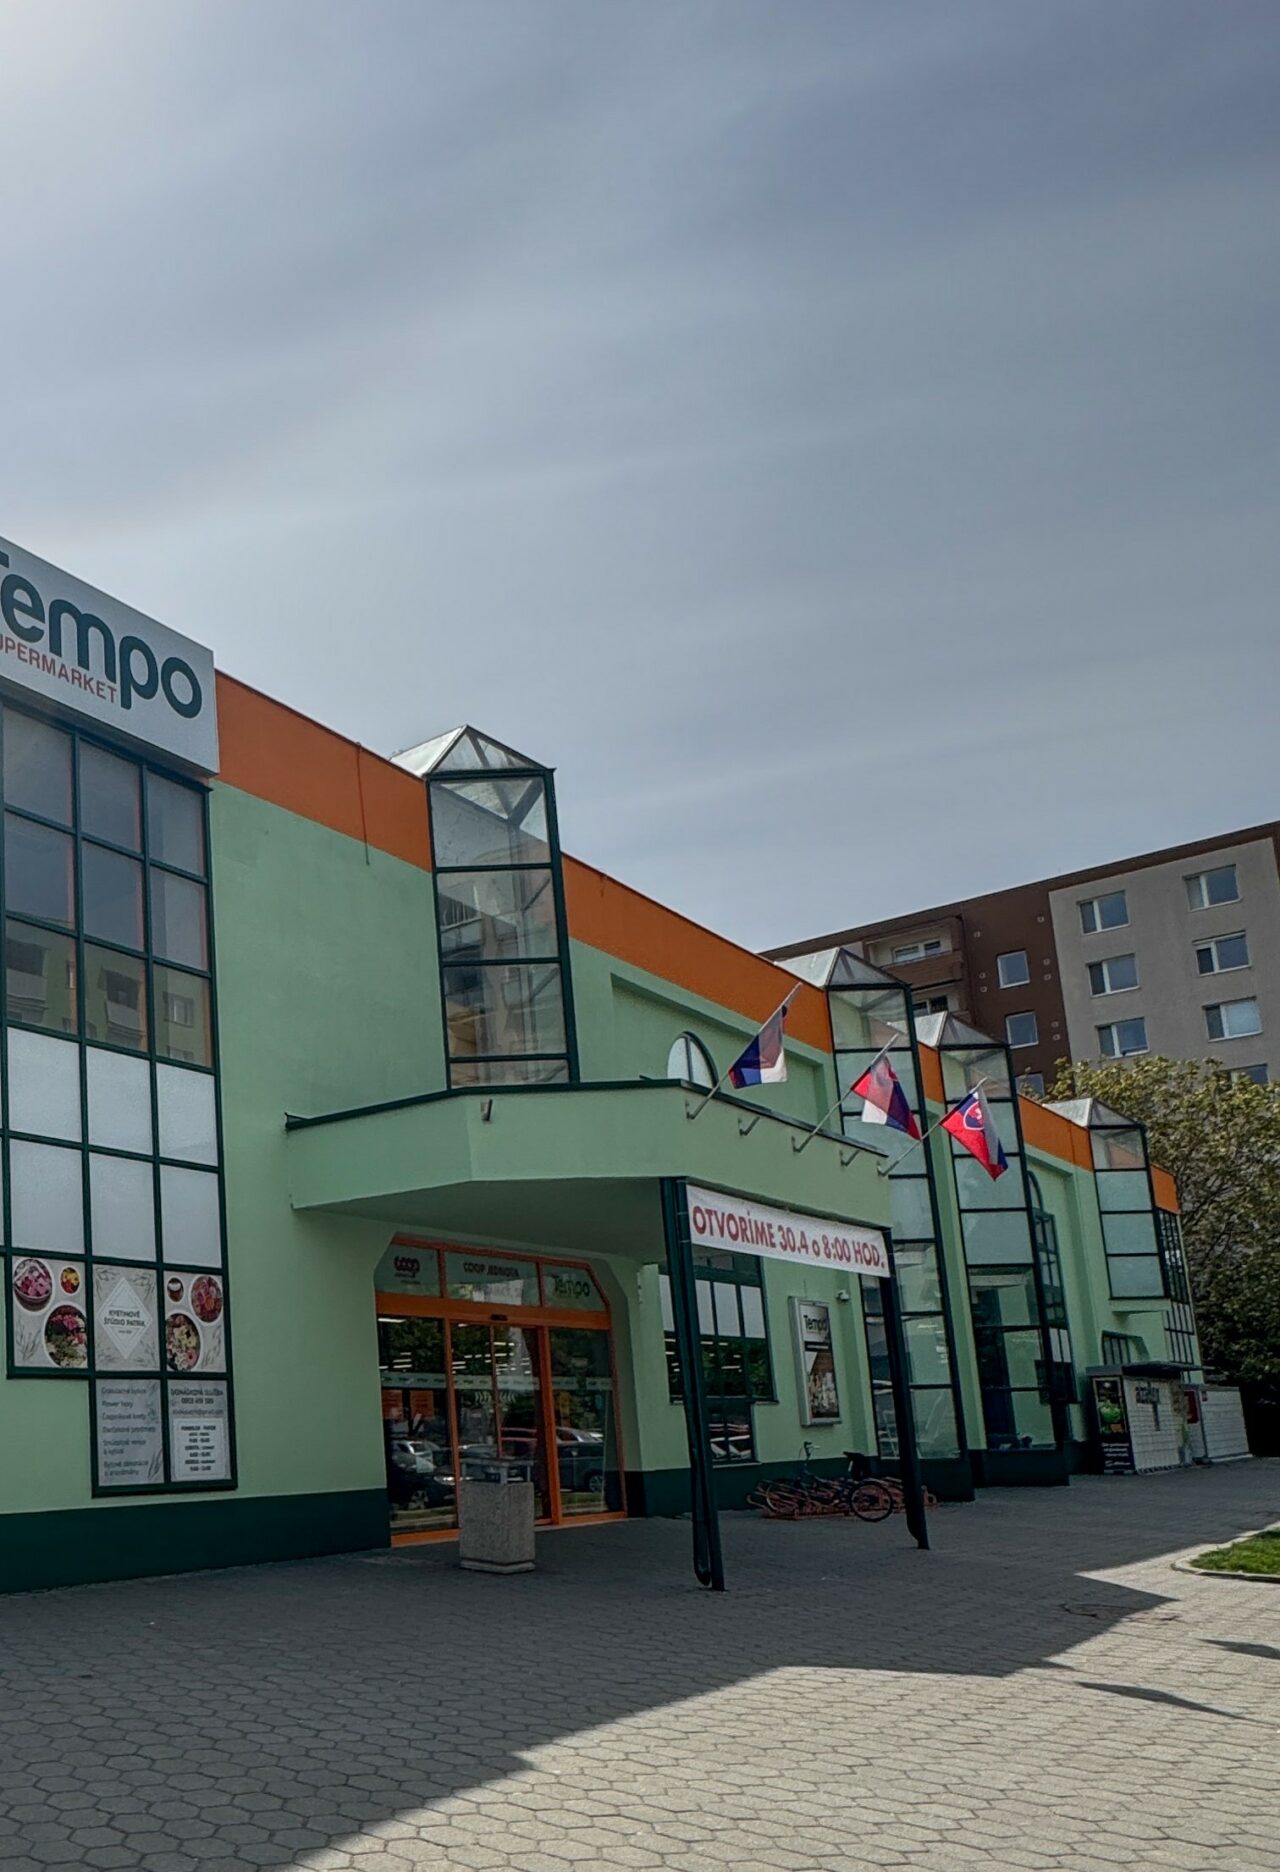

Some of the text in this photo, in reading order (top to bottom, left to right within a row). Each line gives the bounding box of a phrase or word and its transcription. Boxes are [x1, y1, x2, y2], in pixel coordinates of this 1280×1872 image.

[777, 1225, 809, 1255] 30.4
[812, 1239, 821, 1257] o
[822, 1234, 852, 1264] 8:00
[852, 1240, 886, 1269] HOD.
[463, 1261, 486, 1275] COOP
[551, 1274, 592, 1298] Tempo
